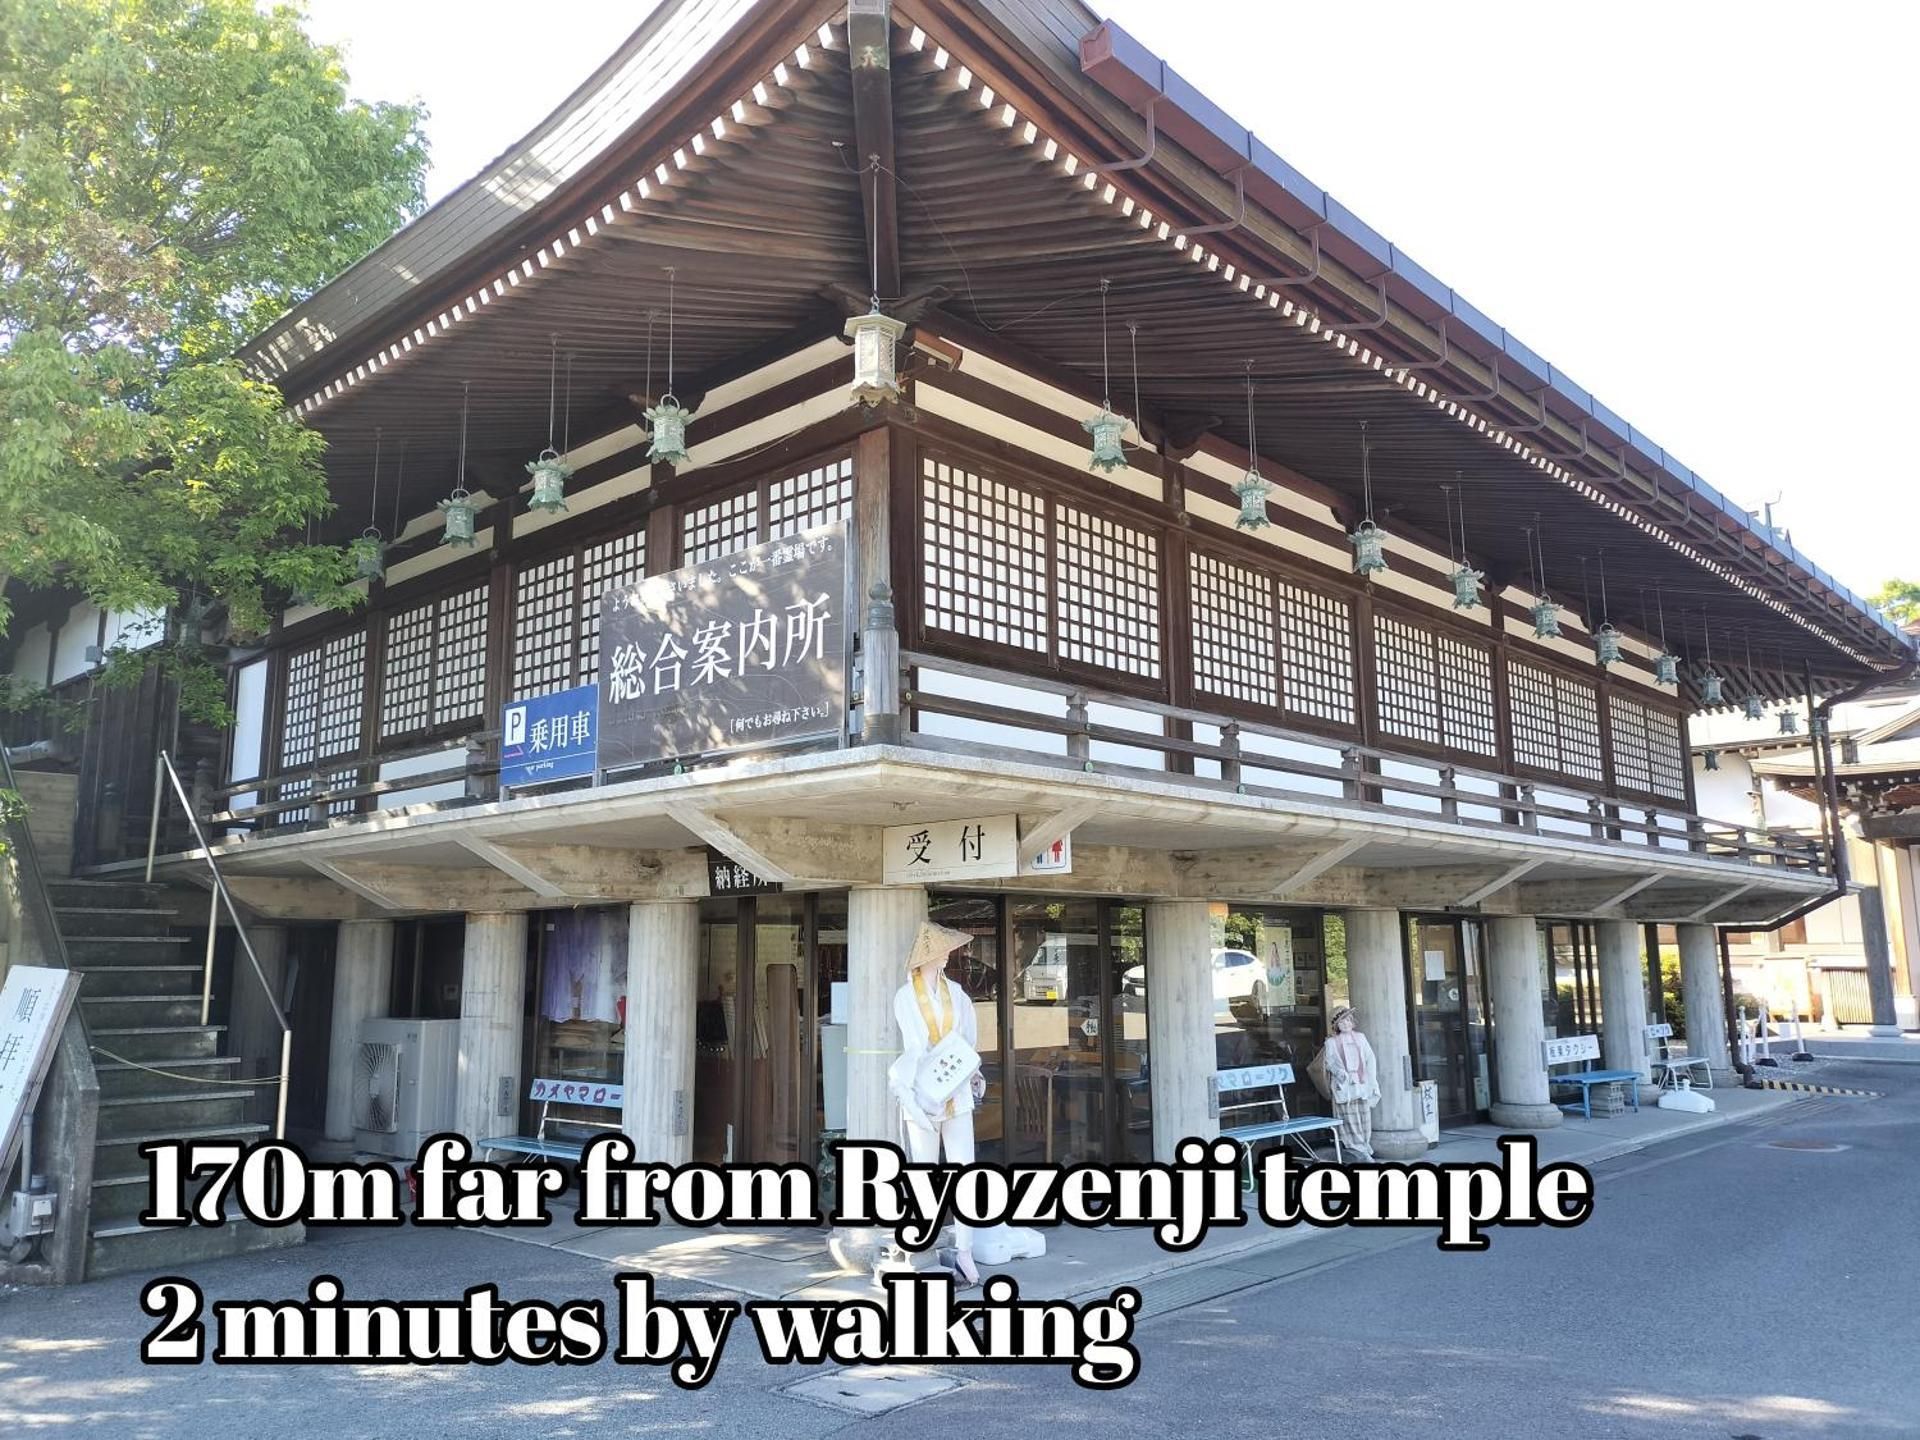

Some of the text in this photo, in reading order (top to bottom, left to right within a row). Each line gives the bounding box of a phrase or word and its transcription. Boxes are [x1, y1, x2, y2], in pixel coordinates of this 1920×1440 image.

[608, 592, 832, 705] 総合案内所
[511, 712, 522, 742] P
[528, 709, 592, 755] 乗用車
[906, 823, 986, 867] 受付
